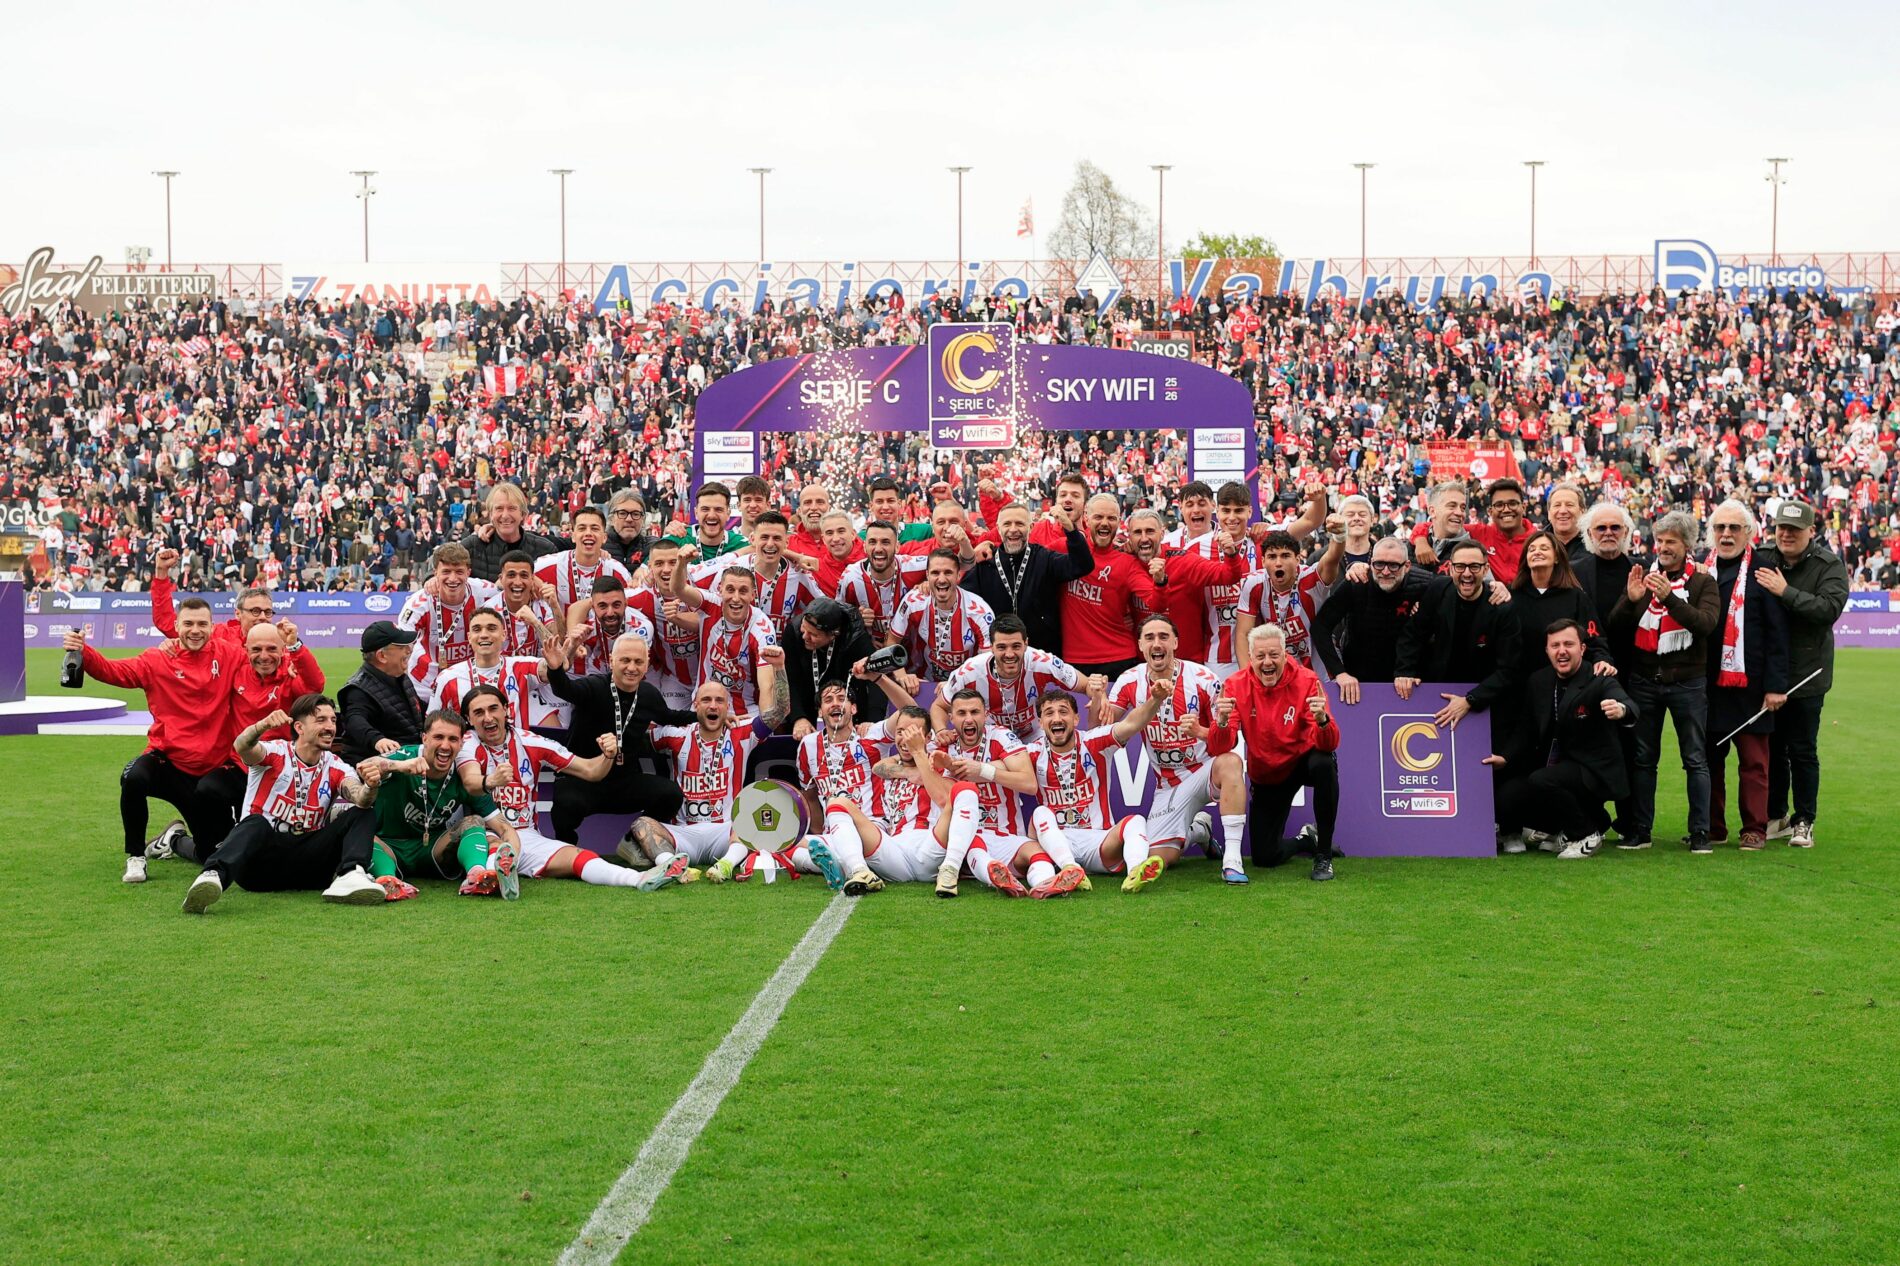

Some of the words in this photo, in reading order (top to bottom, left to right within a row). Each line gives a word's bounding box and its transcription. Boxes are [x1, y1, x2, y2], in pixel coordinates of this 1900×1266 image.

[1719, 265, 1822, 287] Belluscio
[91, 276, 212, 295] PELLETTERIE
[594, 263, 1030, 318] Acciaierie
[1168, 259, 1555, 314] Valbruna
[336, 284, 492, 309] ZANUTTA
[124, 295, 179, 315] SGI
[1047, 378, 1097, 402] SKY
[1102, 377, 1155, 401] WIFI
[1165, 377, 1177, 387] 25
[800, 380, 872, 404] SERIE
[883, 380, 900, 403] C
[1165, 391, 1177, 401] 26
[949, 398, 984, 410] SERIE
[986, 398, 995, 410] C
[707, 437, 721, 446] sky
[723, 437, 739, 445] wifi
[938, 426, 961, 441] sky
[965, 427, 988, 438] wifi
[1197, 434, 1211, 443] sky
[1067, 579, 1103, 602] DIESEL
[1211, 583, 1241, 599] DIES
[53, 598, 69, 609] sky
[446, 645, 473, 661] IESE
[995, 709, 1033, 727] IESEL
[683, 771, 727, 793] DIESEL
[1398, 775, 1429, 785] SERIE
[1431, 775, 1439, 785] C
[1390, 797, 1411, 810] sky
[1413, 798, 1433, 808] wifi
